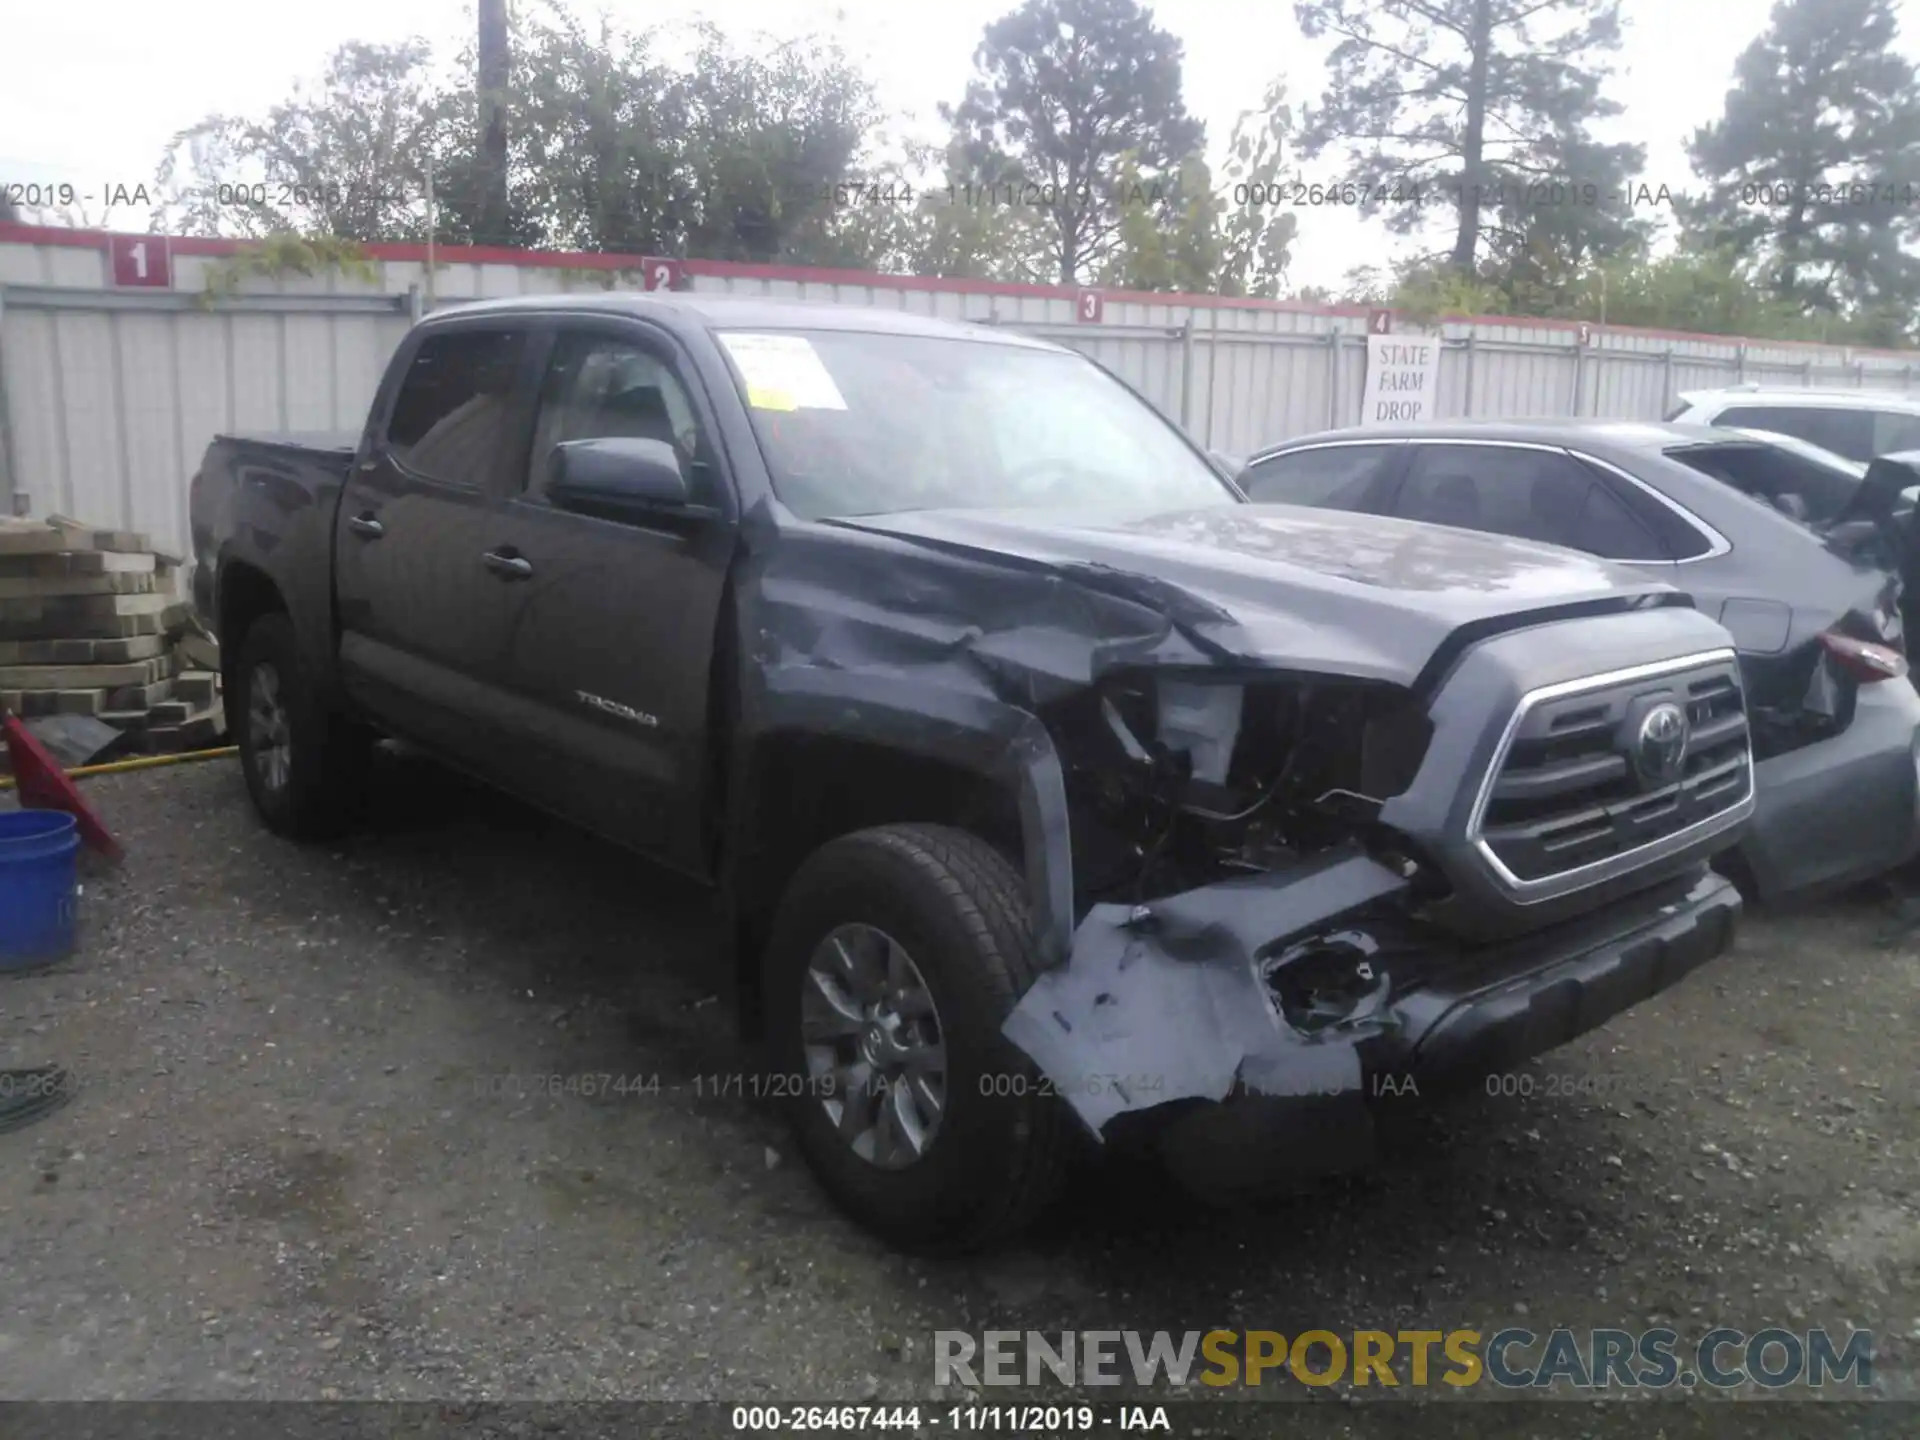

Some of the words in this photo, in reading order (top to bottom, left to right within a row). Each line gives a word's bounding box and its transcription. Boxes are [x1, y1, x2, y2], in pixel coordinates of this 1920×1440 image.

[129, 243, 147, 278] 1
[655, 265, 670, 291] 2
[1085, 294, 1096, 318] 3
[1376, 313, 1386, 333] 4
[1379, 344, 1430, 366] STATE
[1378, 370, 1424, 392] FARM
[1375, 400, 1423, 421] DROP
[574, 689, 658, 727] TACOMA
